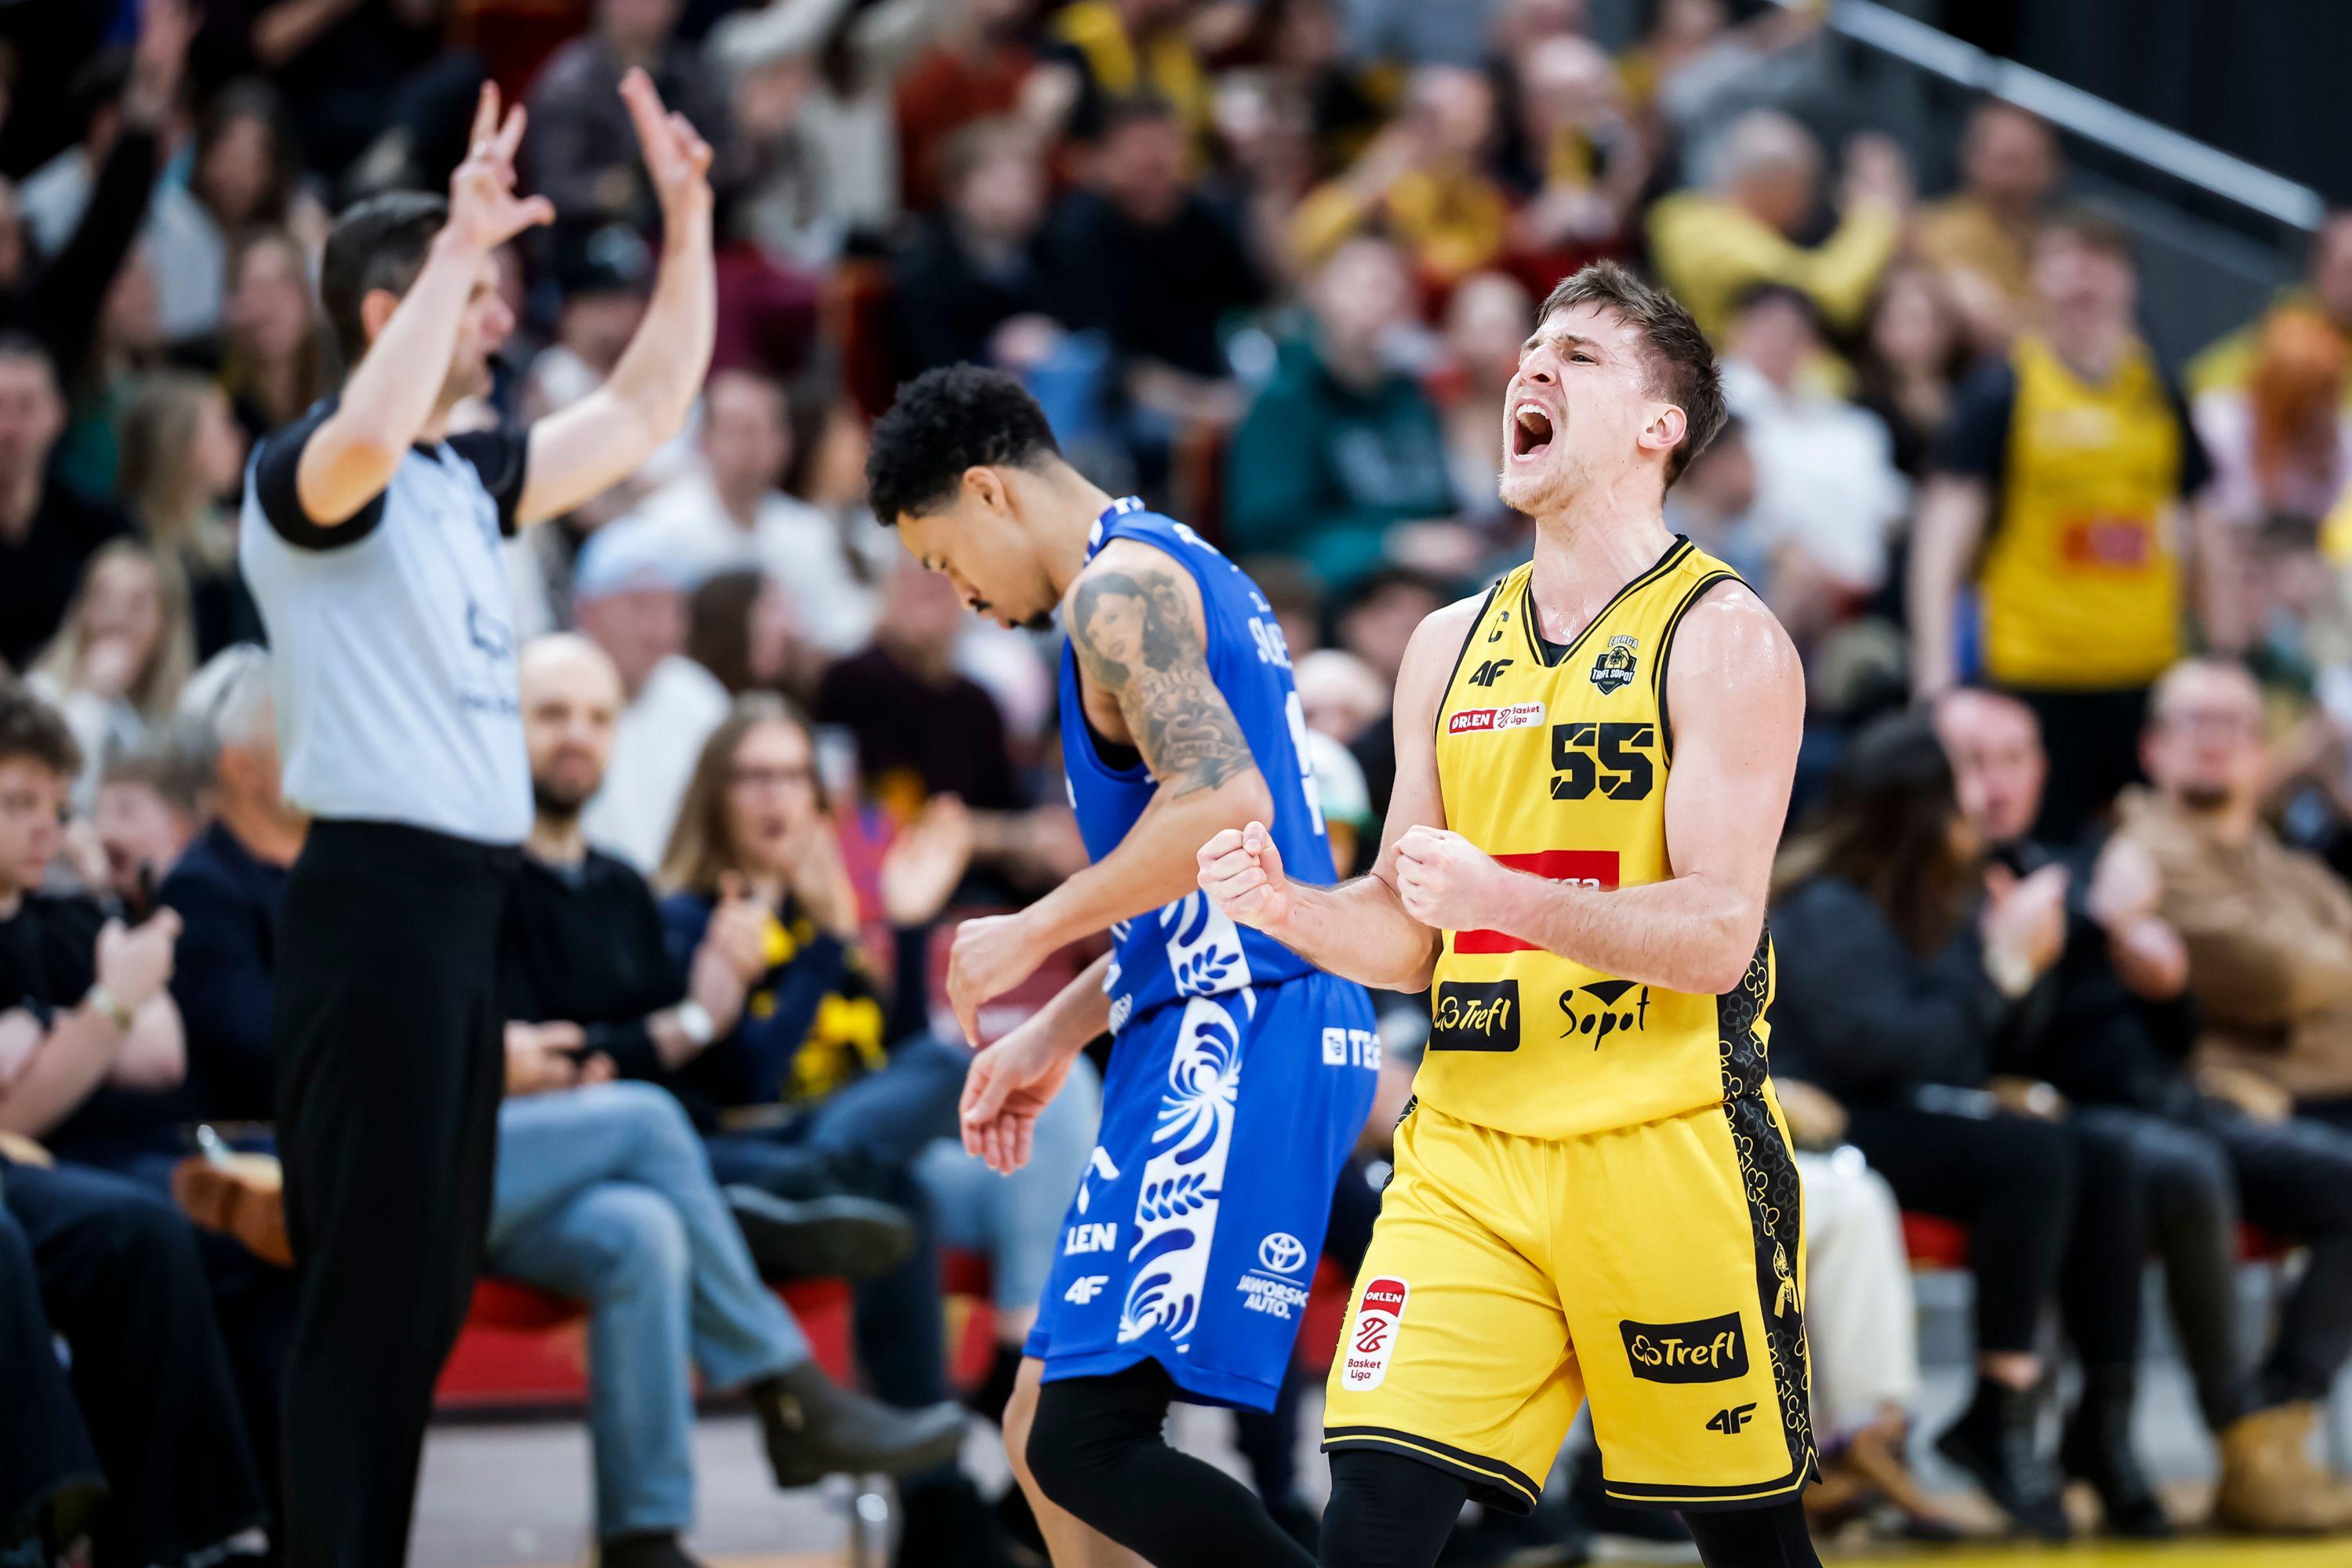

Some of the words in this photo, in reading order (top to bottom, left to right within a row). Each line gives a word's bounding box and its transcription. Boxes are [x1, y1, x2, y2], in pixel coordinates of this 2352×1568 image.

[1488, 611, 1510, 643] C
[1468, 659, 1514, 687] 4F
[1610, 669, 1633, 682] SOPOT
[1451, 711, 1490, 731] ORLEN
[1510, 715, 1527, 725] Liga
[1512, 706, 1541, 714] Basket
[1550, 723, 1654, 800] 55
[1458, 997, 1512, 1037] Trefl
[1559, 985, 1650, 1051] Sopot
[1064, 1275, 1110, 1305] 4F
[1365, 1291, 1403, 1304] ORLEN
[1659, 1330, 1736, 1369] Trefl
[1348, 1359, 1381, 1370] Basket
[1351, 1370, 1371, 1381] Liga
[1705, 1402, 1758, 1435] 4F
